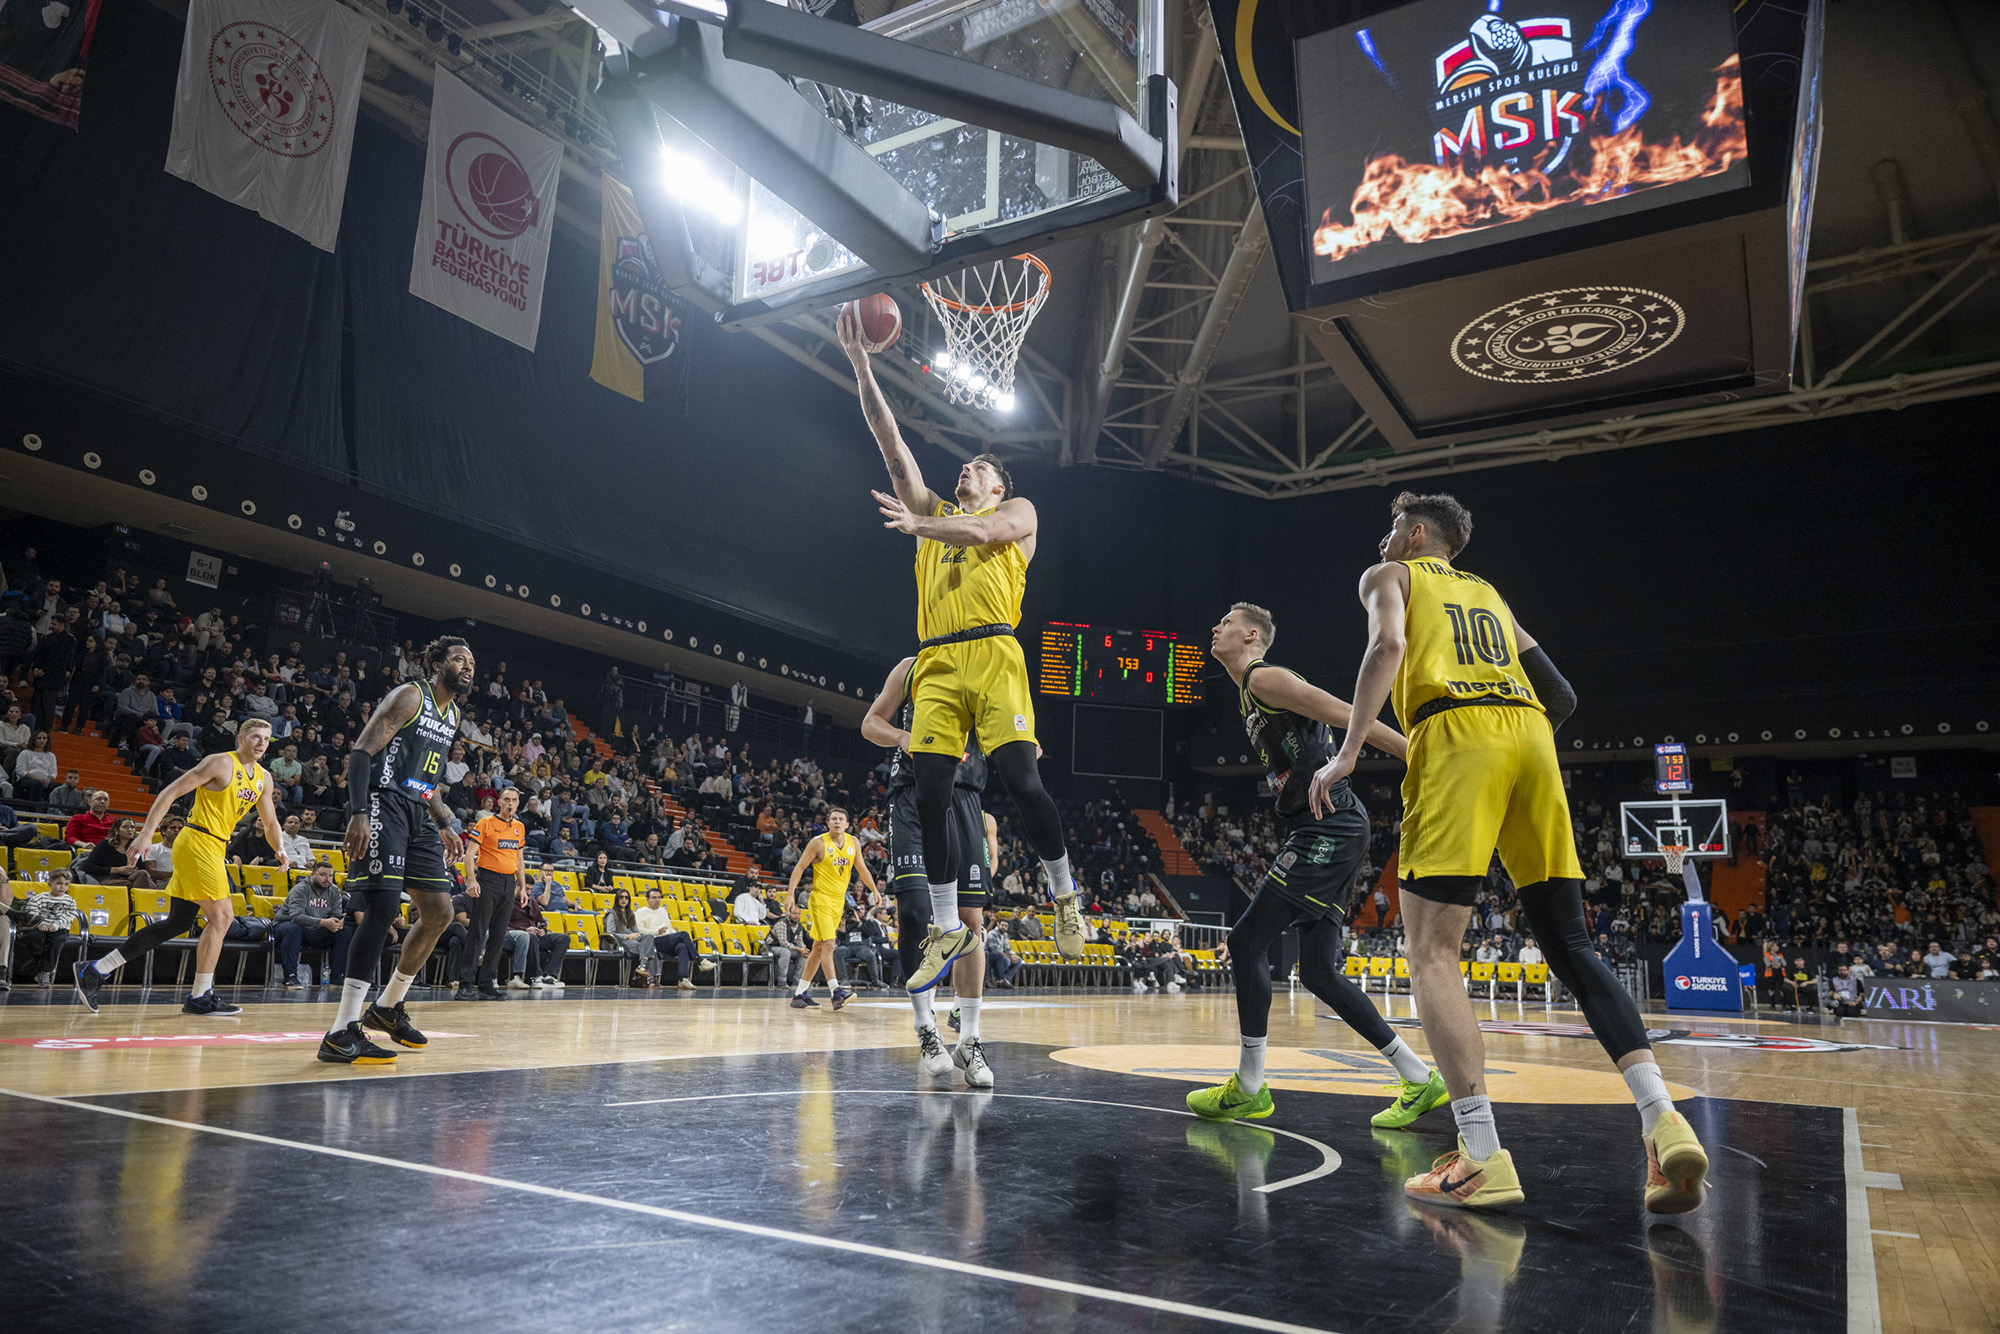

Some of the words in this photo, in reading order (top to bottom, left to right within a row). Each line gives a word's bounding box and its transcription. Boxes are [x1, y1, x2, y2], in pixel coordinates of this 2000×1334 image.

[1488, 75, 1521, 92] SPOR
[1528, 61, 1579, 82] KULÜBÜ
[1433, 89, 1586, 166] MSK
[437, 218, 531, 286] TÜRKİYE
[434, 239, 528, 300] BASKETBOL
[432, 254, 526, 312] FEDERASYONU
[610, 288, 682, 345] MSK
[1501, 323, 1521, 334] VE
[1518, 310, 1557, 326] SPOR
[196, 558, 213, 570] G-1
[941, 544, 967, 564] 22
[189, 568, 217, 582] BLOK
[1104, 635, 1112, 647] 6
[1145, 639, 1153, 651] 3
[1443, 602, 1511, 667] 10
[1145, 672, 1153, 683] 0
[1446, 674, 1533, 701] mersin
[423, 750, 441, 775] 15
[1667, 765, 1682, 781] 12
[237, 787, 257, 804] MSK
[369, 791, 384, 858] ecogreen
[832, 857, 850, 866] MSK
